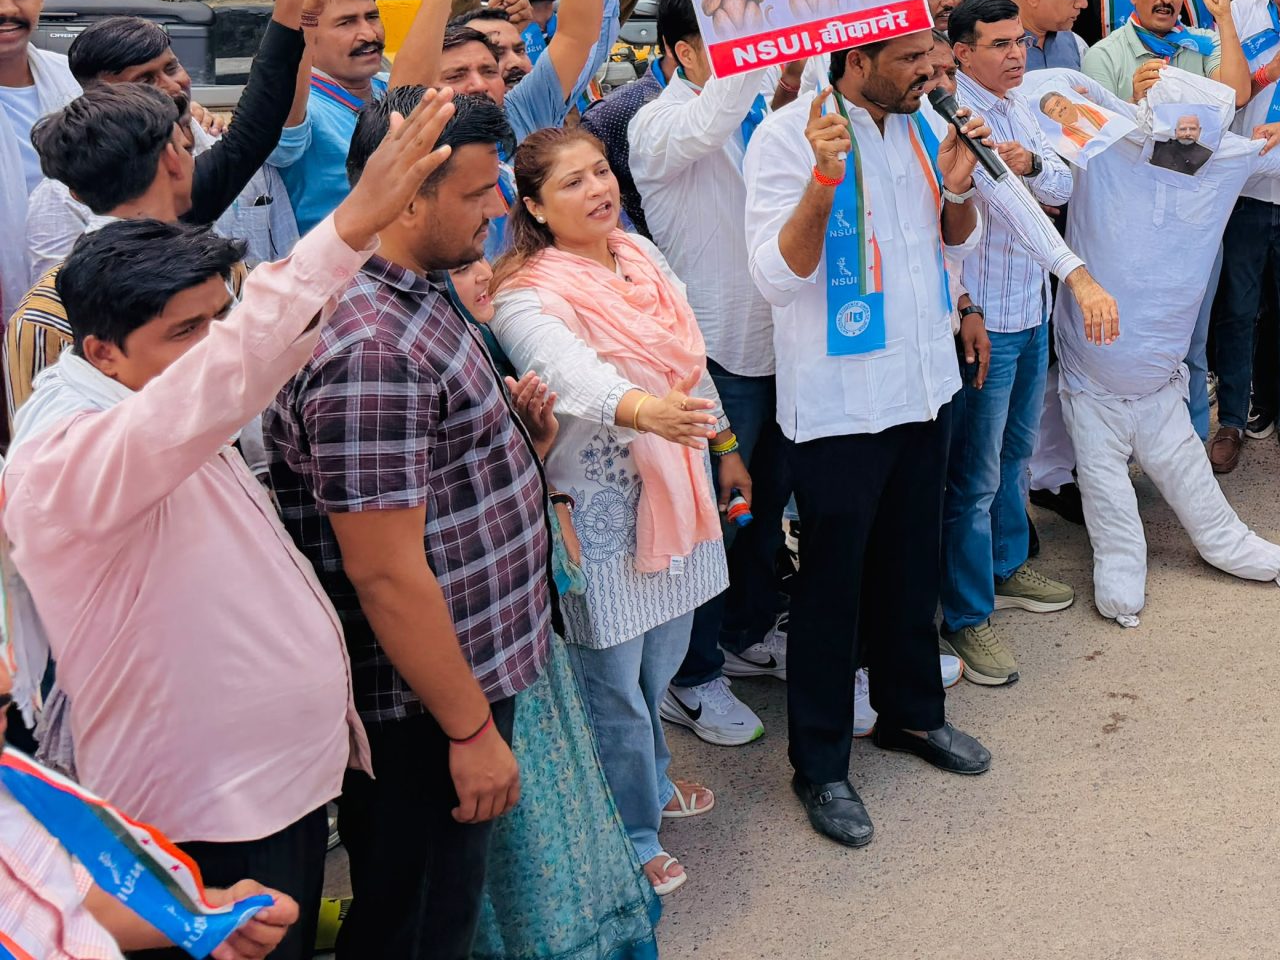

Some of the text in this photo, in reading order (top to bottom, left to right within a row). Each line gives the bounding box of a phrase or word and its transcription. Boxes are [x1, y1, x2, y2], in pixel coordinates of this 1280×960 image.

[732, 9, 909, 68] NSUI,बीकानेर
[829, 226, 857, 238] NSUI
[831, 276, 857, 287] NSUI
